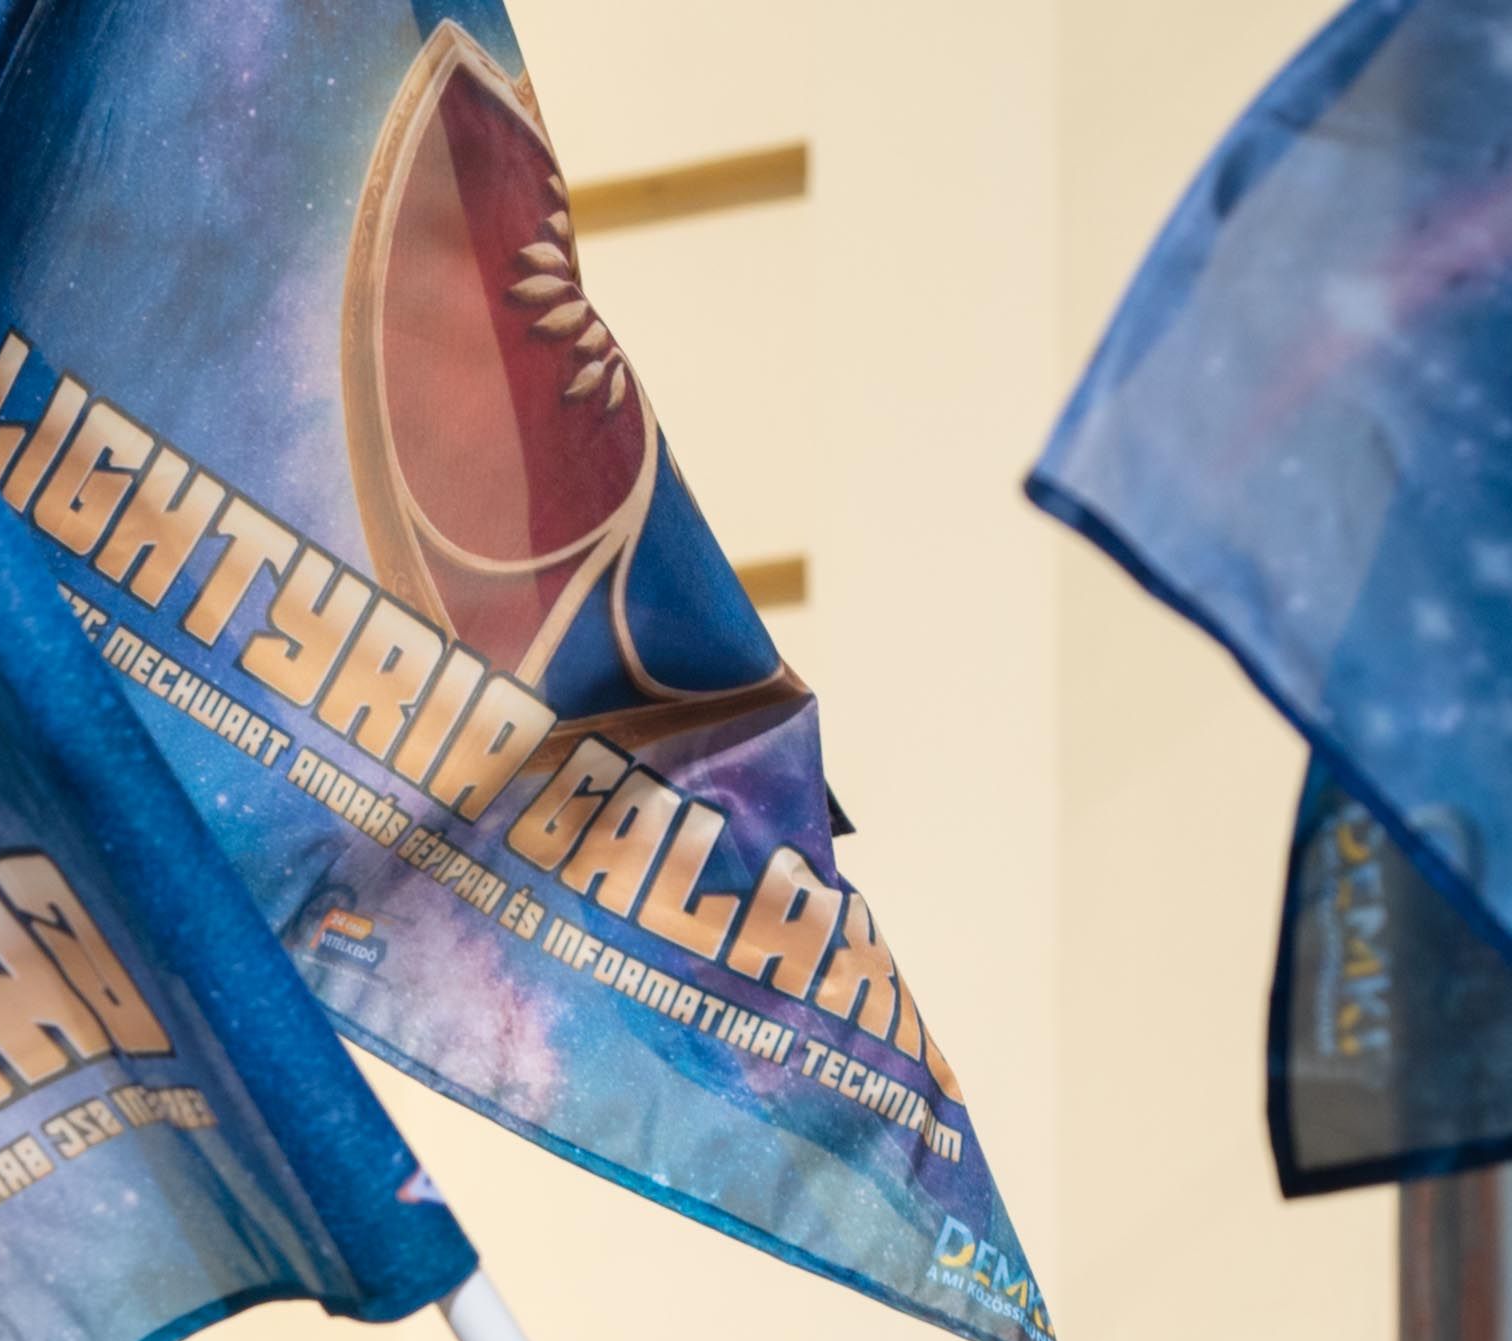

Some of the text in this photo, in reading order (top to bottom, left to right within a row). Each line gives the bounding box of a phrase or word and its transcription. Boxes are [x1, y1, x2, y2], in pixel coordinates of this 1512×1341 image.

[102, 624, 292, 769] MECHWART
[286, 745, 410, 850] ANDRÁS
[398, 828, 508, 914] GÉPIPARI
[498, 885, 544, 941] ÉS
[542, 917, 797, 1066] INFORMATIKAI
[800, 1037, 964, 1165] TECHNIKUM
[926, 1264, 938, 1281] A
[941, 1271, 964, 1290] MI
